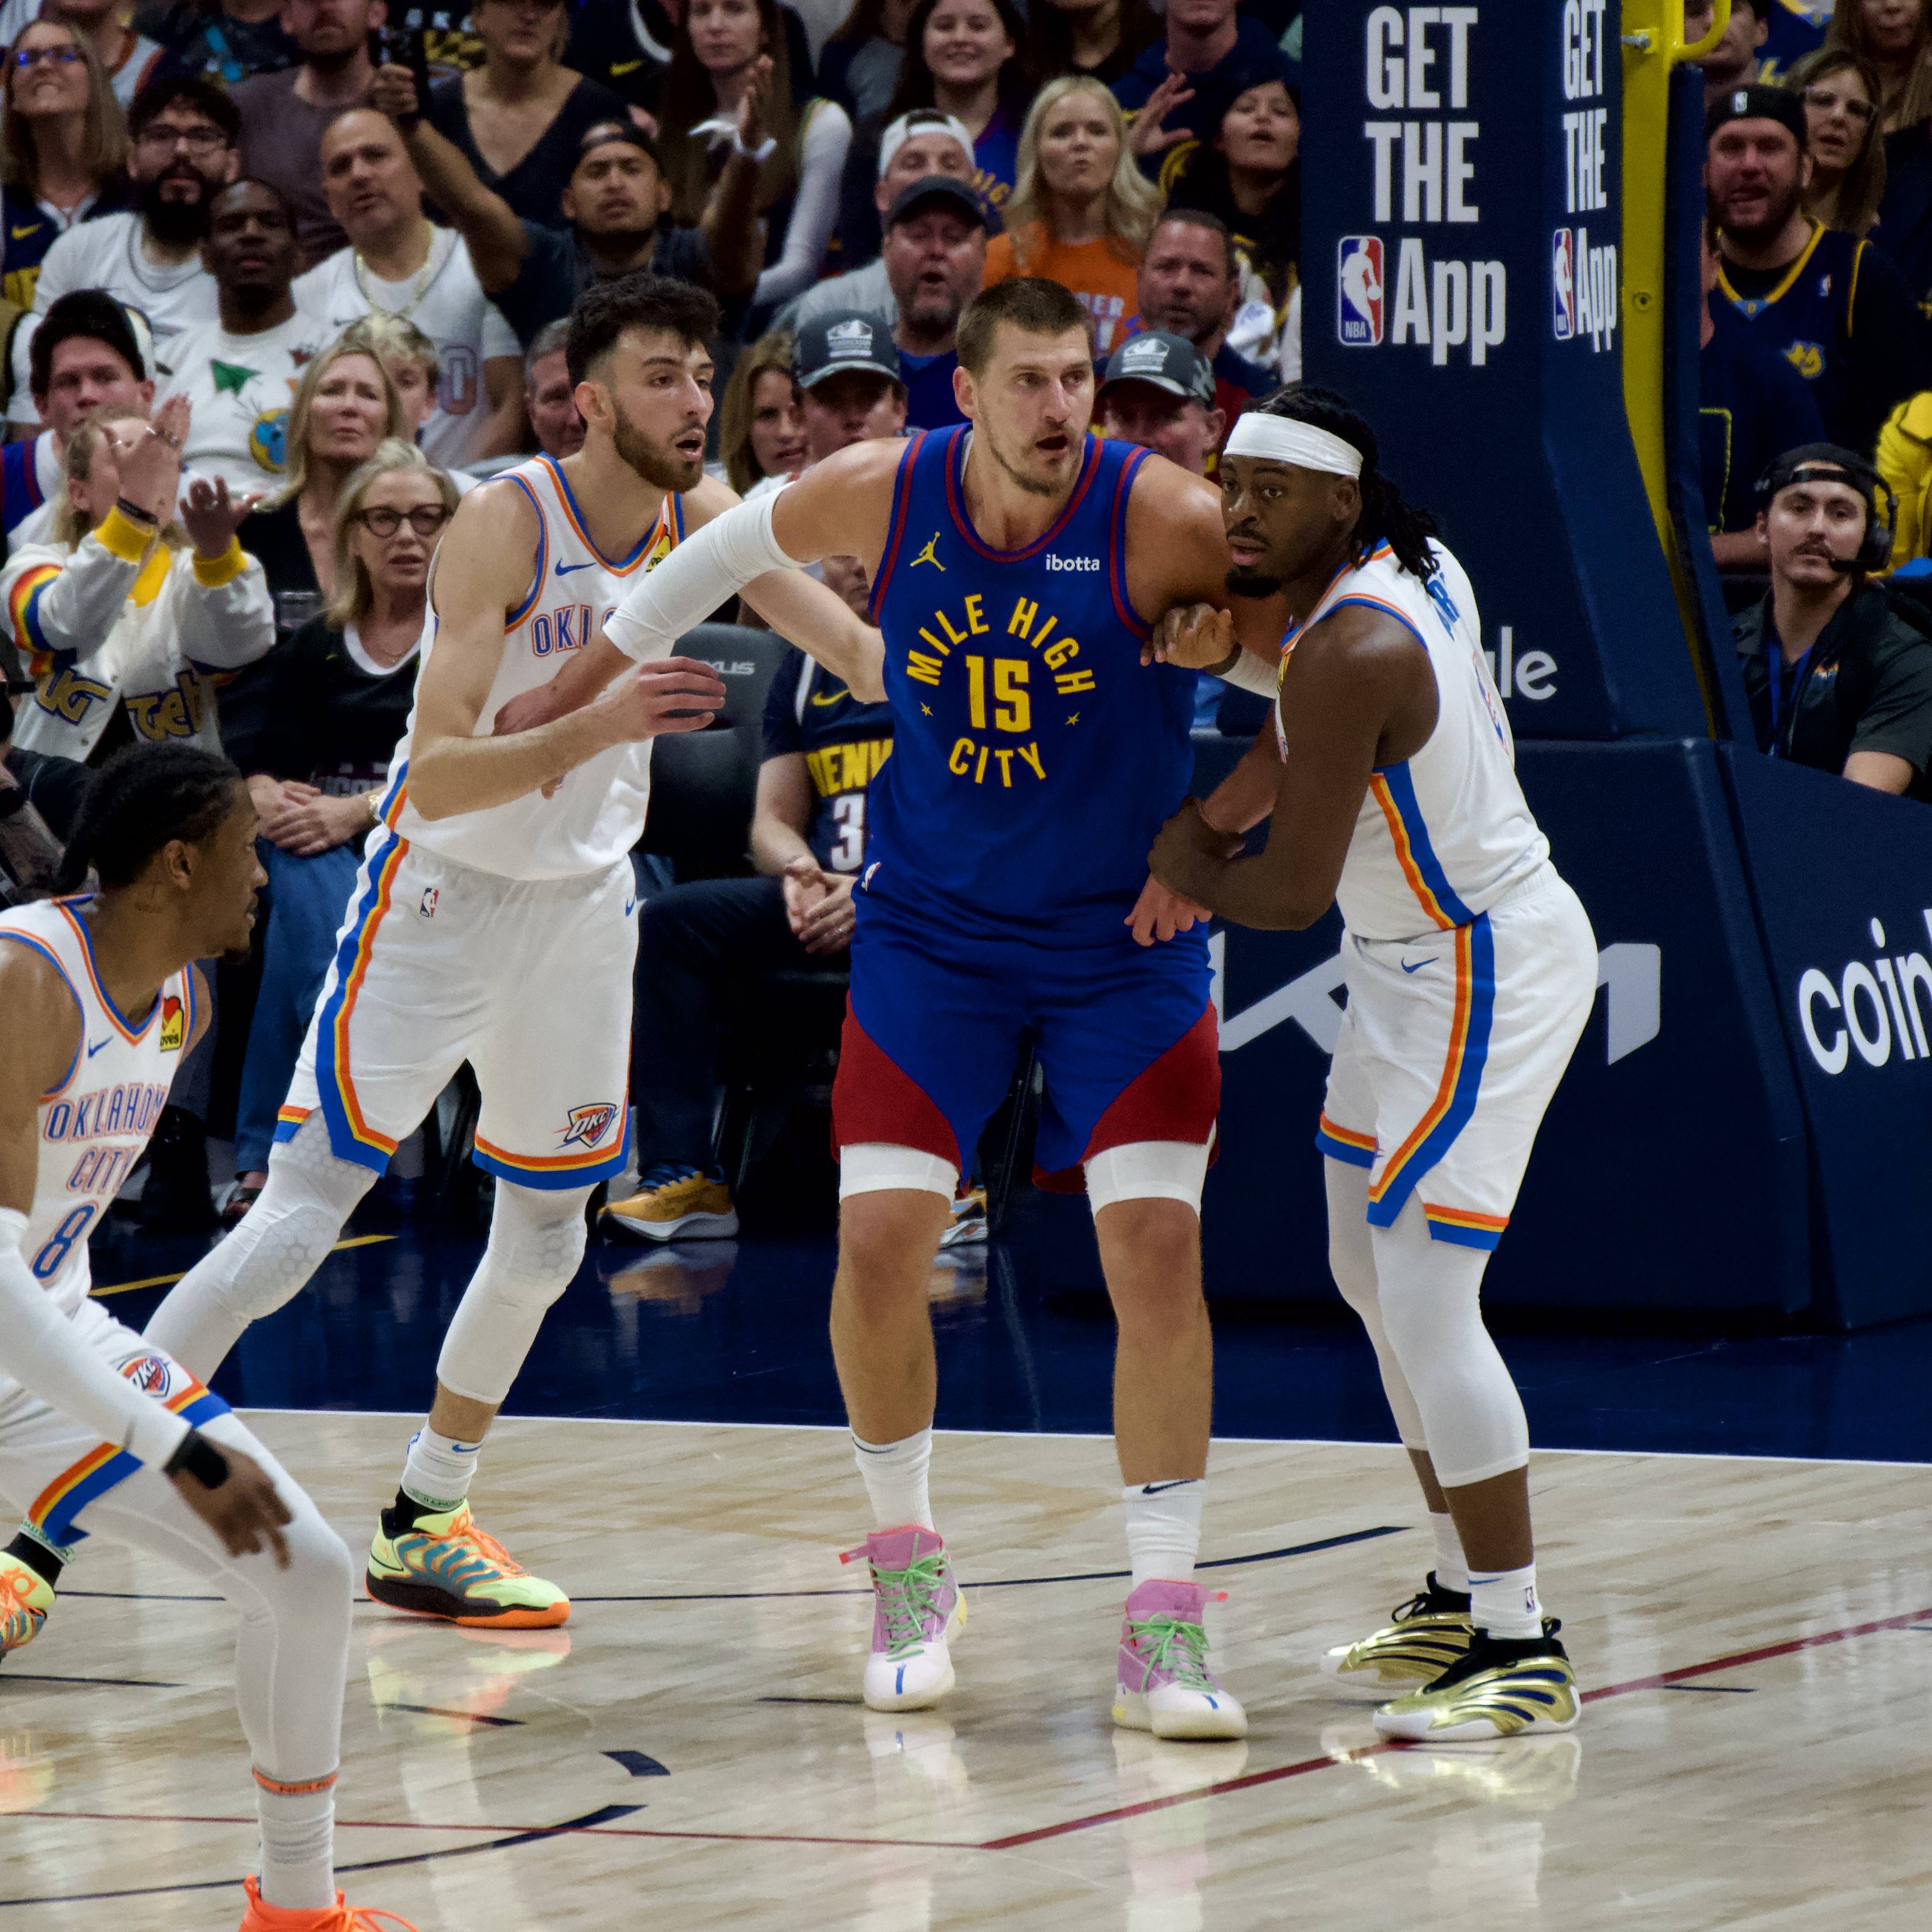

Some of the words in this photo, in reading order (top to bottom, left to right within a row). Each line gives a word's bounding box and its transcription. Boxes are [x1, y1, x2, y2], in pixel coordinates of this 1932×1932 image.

[1367, 6, 1478, 109] GET
[1564, 0, 1606, 100] GET
[1364, 122, 1479, 222] THE
[1564, 108, 1607, 213] THE
[1346, 321, 1366, 338] NBA
[1392, 238, 1506, 366] App
[1576, 227, 1617, 353] App
[1045, 554, 1100, 571] ibotta
[906, 593, 990, 686] MILE
[1007, 596, 1096, 695] HIGH
[965, 655, 1032, 733] 15
[948, 737, 1047, 788] CITY
[831, 794, 865, 872] 3
[1799, 909, 1932, 1075] coin
[29, 1200, 99, 1290] 8
